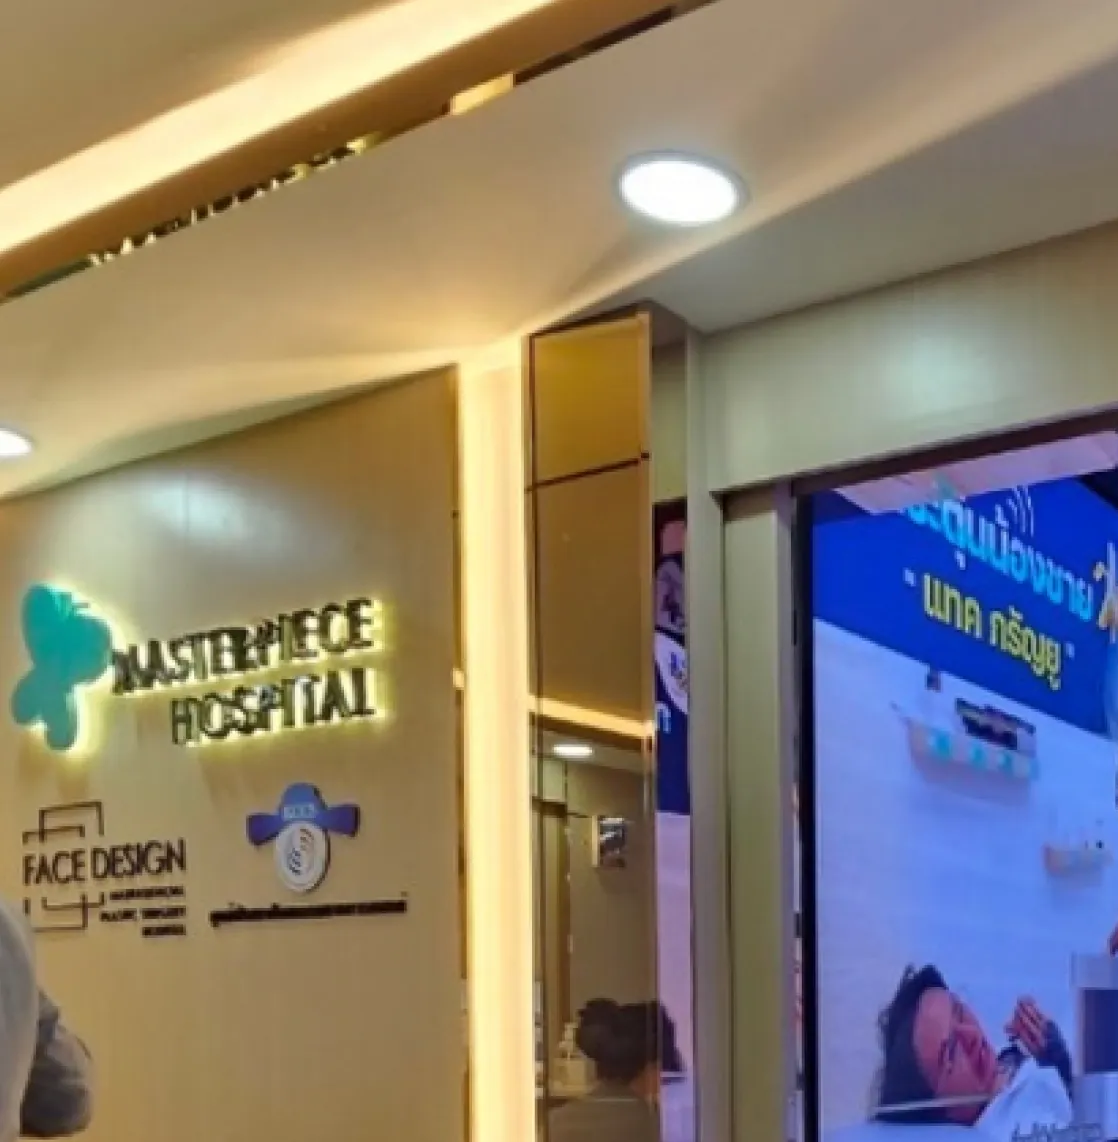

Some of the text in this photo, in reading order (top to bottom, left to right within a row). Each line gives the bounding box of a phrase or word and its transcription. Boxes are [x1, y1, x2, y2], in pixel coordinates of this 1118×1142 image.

[111, 598, 373, 695] MASTERPIECE
[172, 667, 375, 744] HOSPITAL
[23, 837, 185, 885] FACE DESIGN
